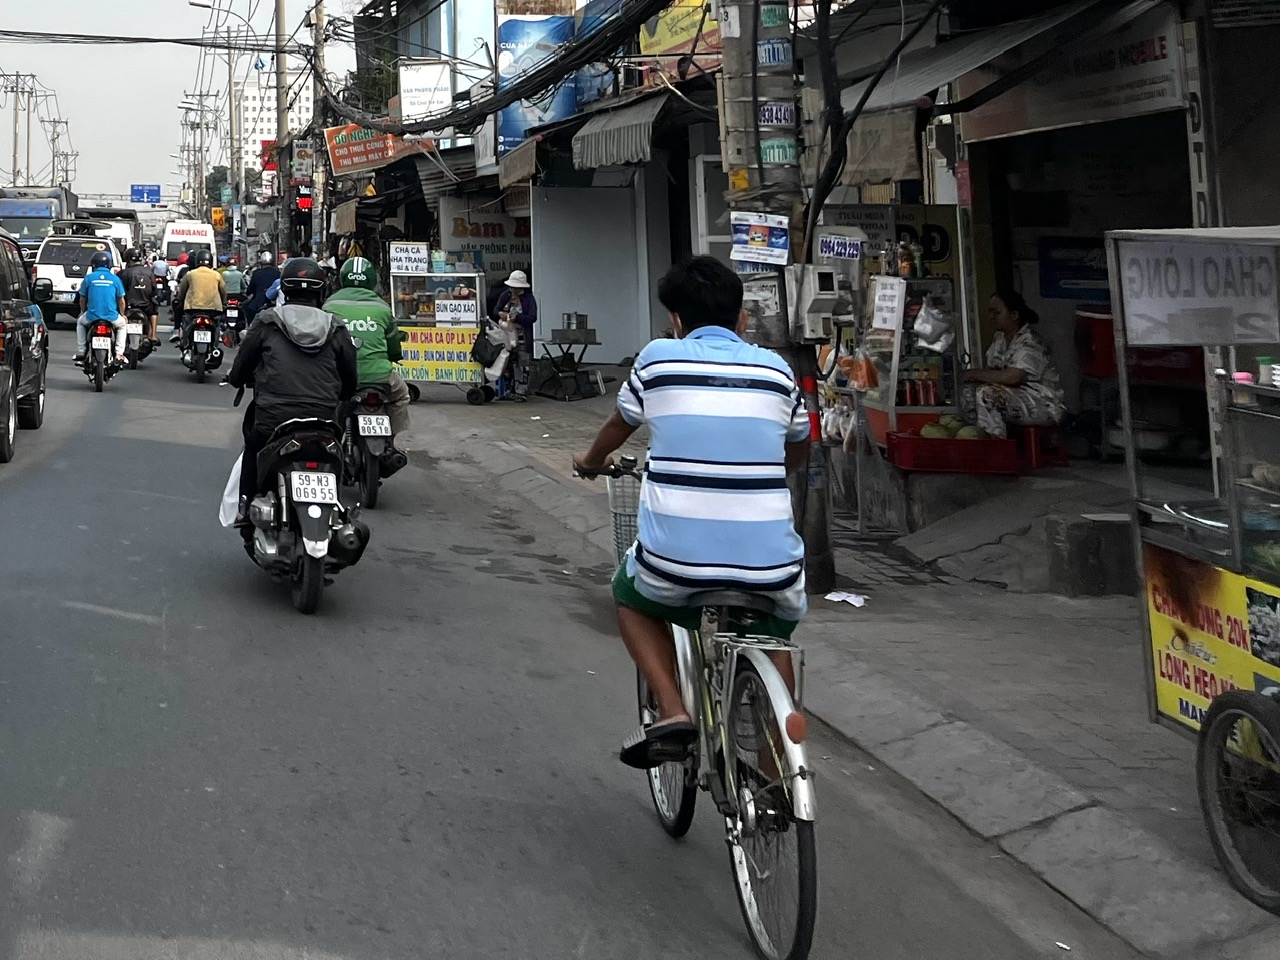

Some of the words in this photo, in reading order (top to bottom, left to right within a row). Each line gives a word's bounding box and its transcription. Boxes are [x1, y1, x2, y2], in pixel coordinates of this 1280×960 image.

[335, 148, 348, 157] CHO
[339, 157, 351, 166] THU
[353, 154, 367, 163] MUA
[865, 211, 885, 220] MUA
[451, 217, 505, 238] Bam
[171, 229, 208, 237] AMBULANCE
[348, 273, 367, 281] Grab
[436, 301, 448, 313] BÚN
[299, 475, 329, 487] 59-N3
